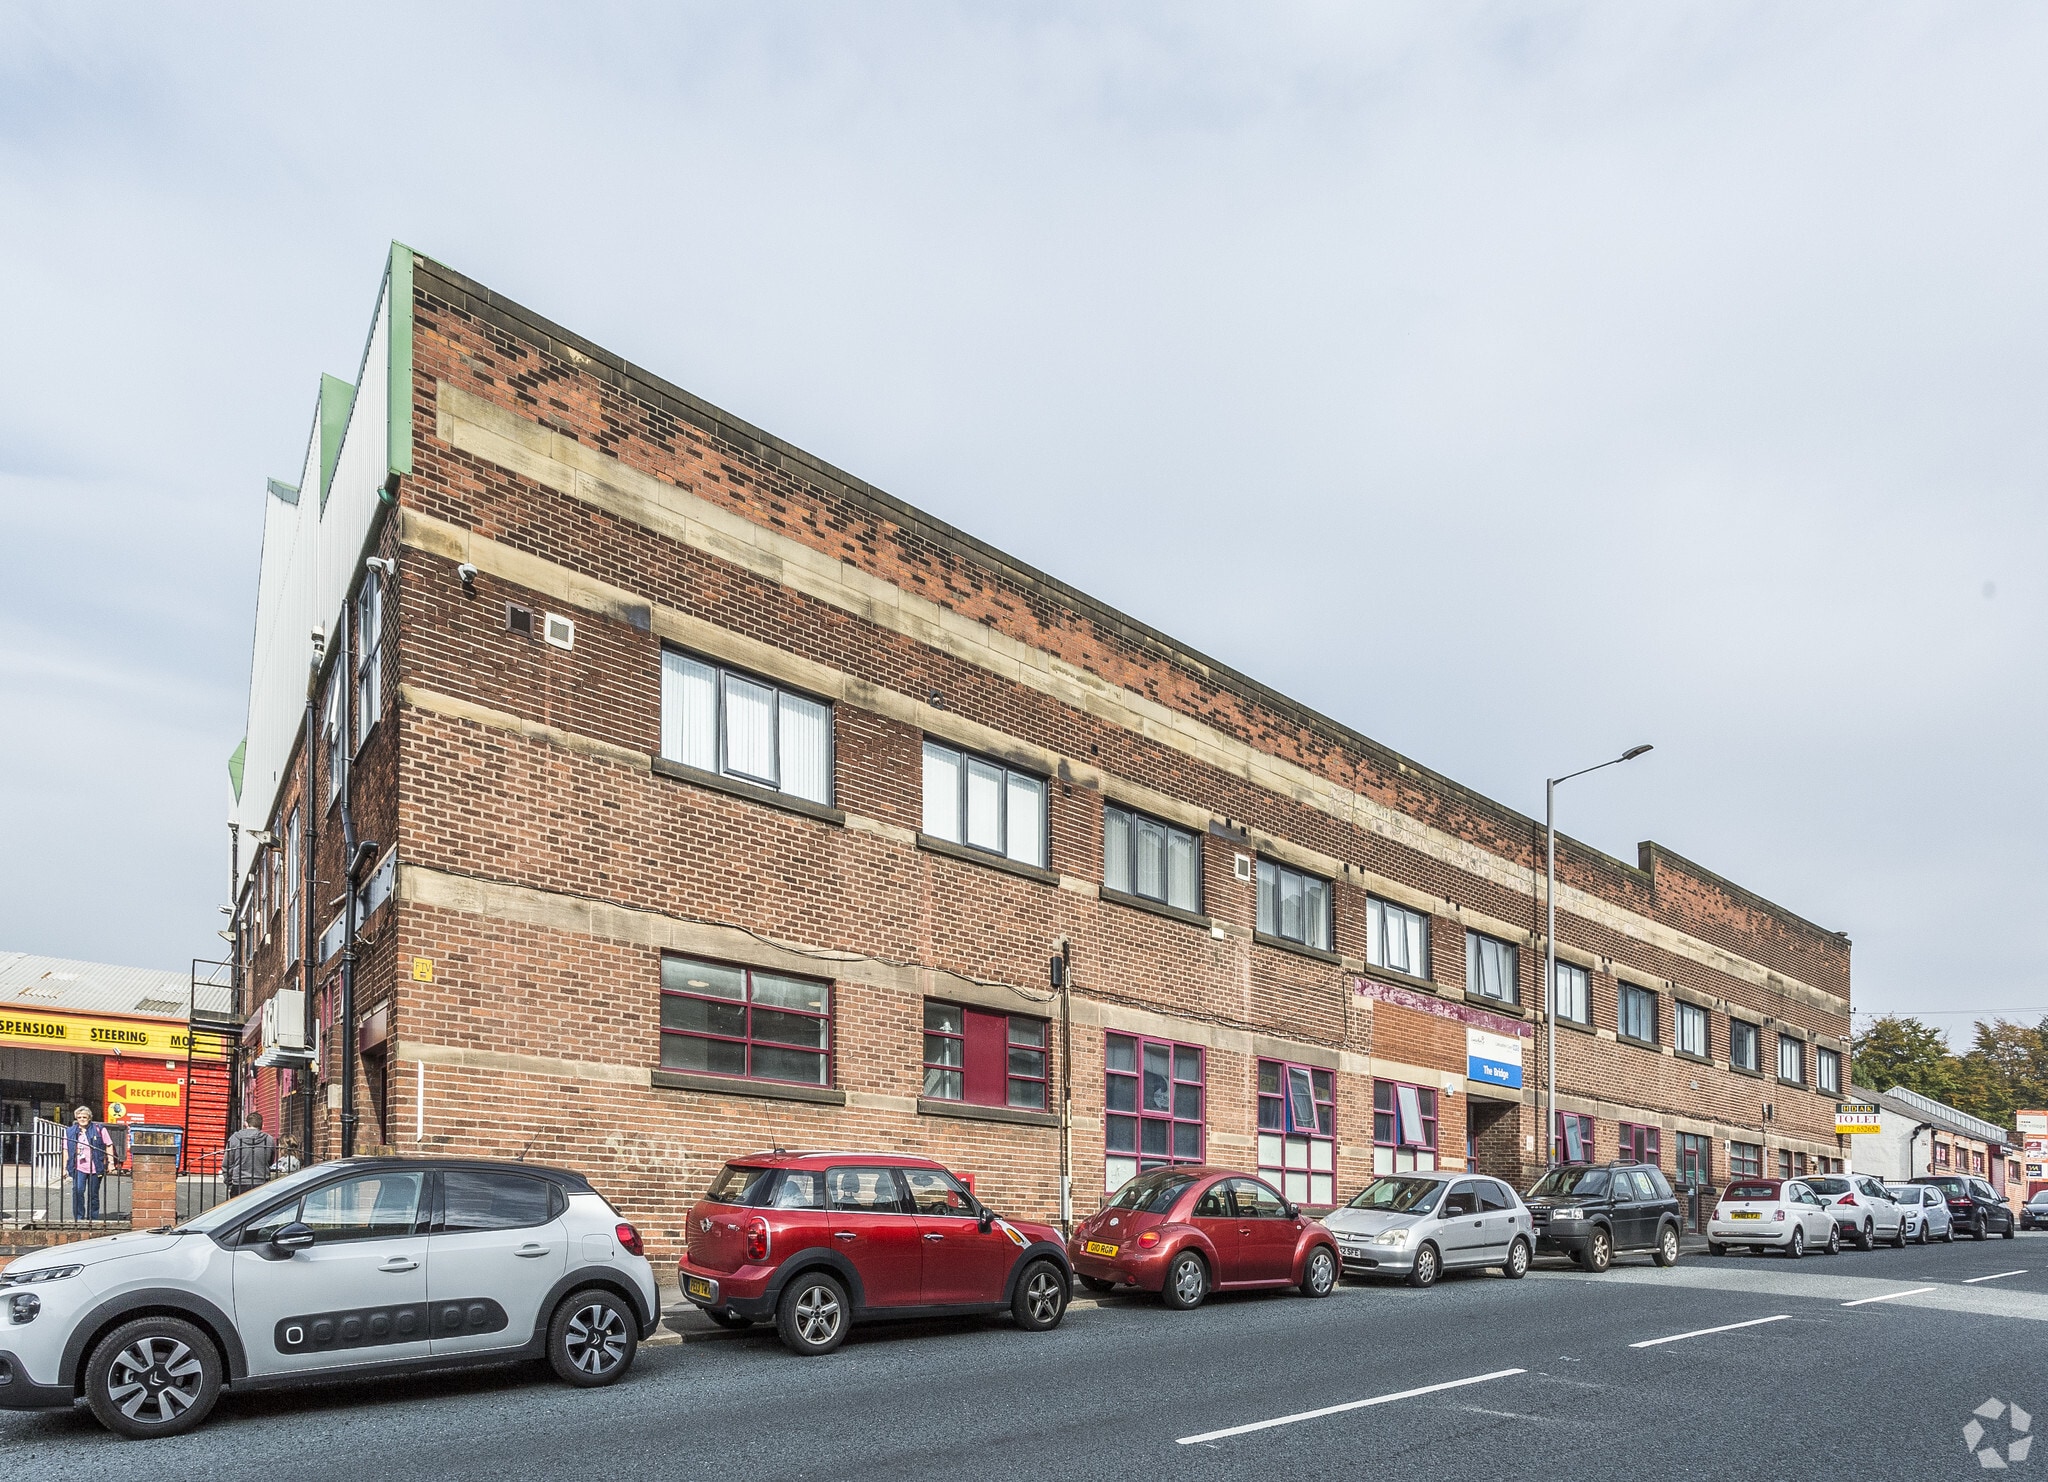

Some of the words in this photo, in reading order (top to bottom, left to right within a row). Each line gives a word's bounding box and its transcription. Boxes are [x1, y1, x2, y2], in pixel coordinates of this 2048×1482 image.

[90, 1028, 147, 1042] STEERING
[1483, 1065, 1493, 1075] The
[1493, 1067, 1509, 1080] Bridge
[130, 1088, 177, 1099] RECEPTION
[1837, 1115, 1853, 1124] TO
[1856, 1115, 1879, 1124] LET
[1837, 1125, 1855, 1133] 01772
[1856, 1125, 1879, 1133] 652652
[1100, 1245, 1114, 1255] RGR
